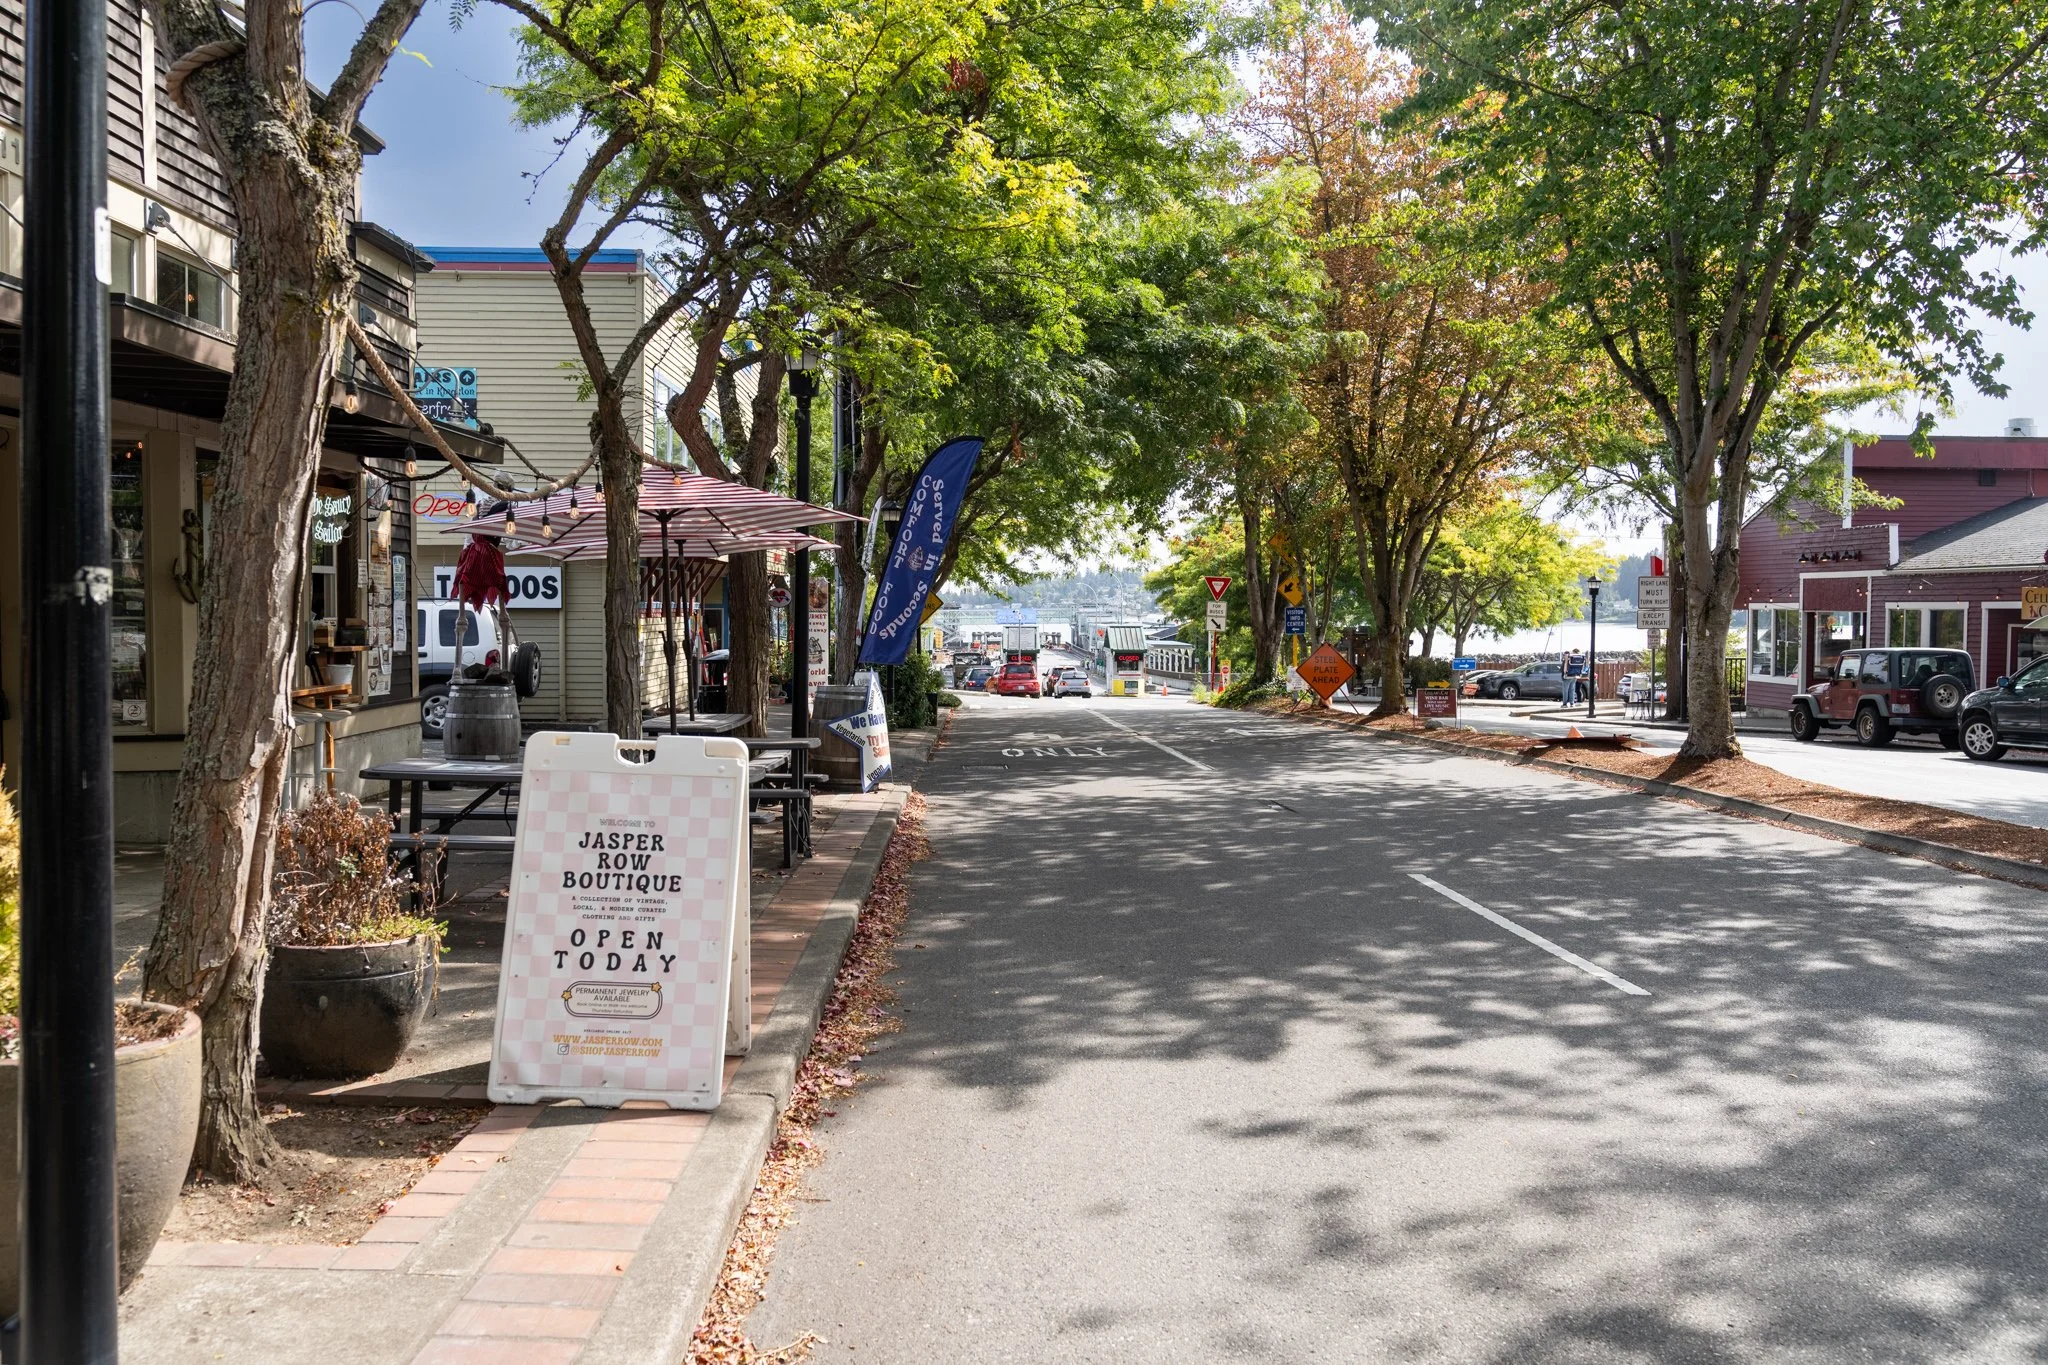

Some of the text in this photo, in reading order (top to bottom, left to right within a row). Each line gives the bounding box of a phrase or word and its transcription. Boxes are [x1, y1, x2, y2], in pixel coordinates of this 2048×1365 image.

[437, 387, 475, 397] Kington
[324, 495, 352, 518] Saucy
[893, 475, 932, 569] COMFORT
[879, 478, 945, 640] Served in Seconds
[437, 575, 559, 599] TOOS
[869, 582, 894, 635] FOOD
[1315, 656, 1337, 664] STEEL
[850, 715, 867, 730] We
[835, 723, 866, 747] Vegetarian
[1001, 747, 1108, 757] ONLY
[866, 764, 884, 782] Vegan
[599, 819, 656, 828] WELCOME TO
[578, 831, 665, 851] JASPER
[597, 852, 652, 871] ROW
[562, 870, 682, 894] BOUTIQUE
[570, 928, 664, 950] OPEN
[553, 950, 676, 973] TODAY
[575, 987, 650, 996] PERMANENT JEWELRY
[593, 995, 631, 1003] AVAILABLE
[552, 1034, 663, 1047] WWW.JASPERROW.COM
[571, 1045, 660, 1057] @SHOPJASPERROW
